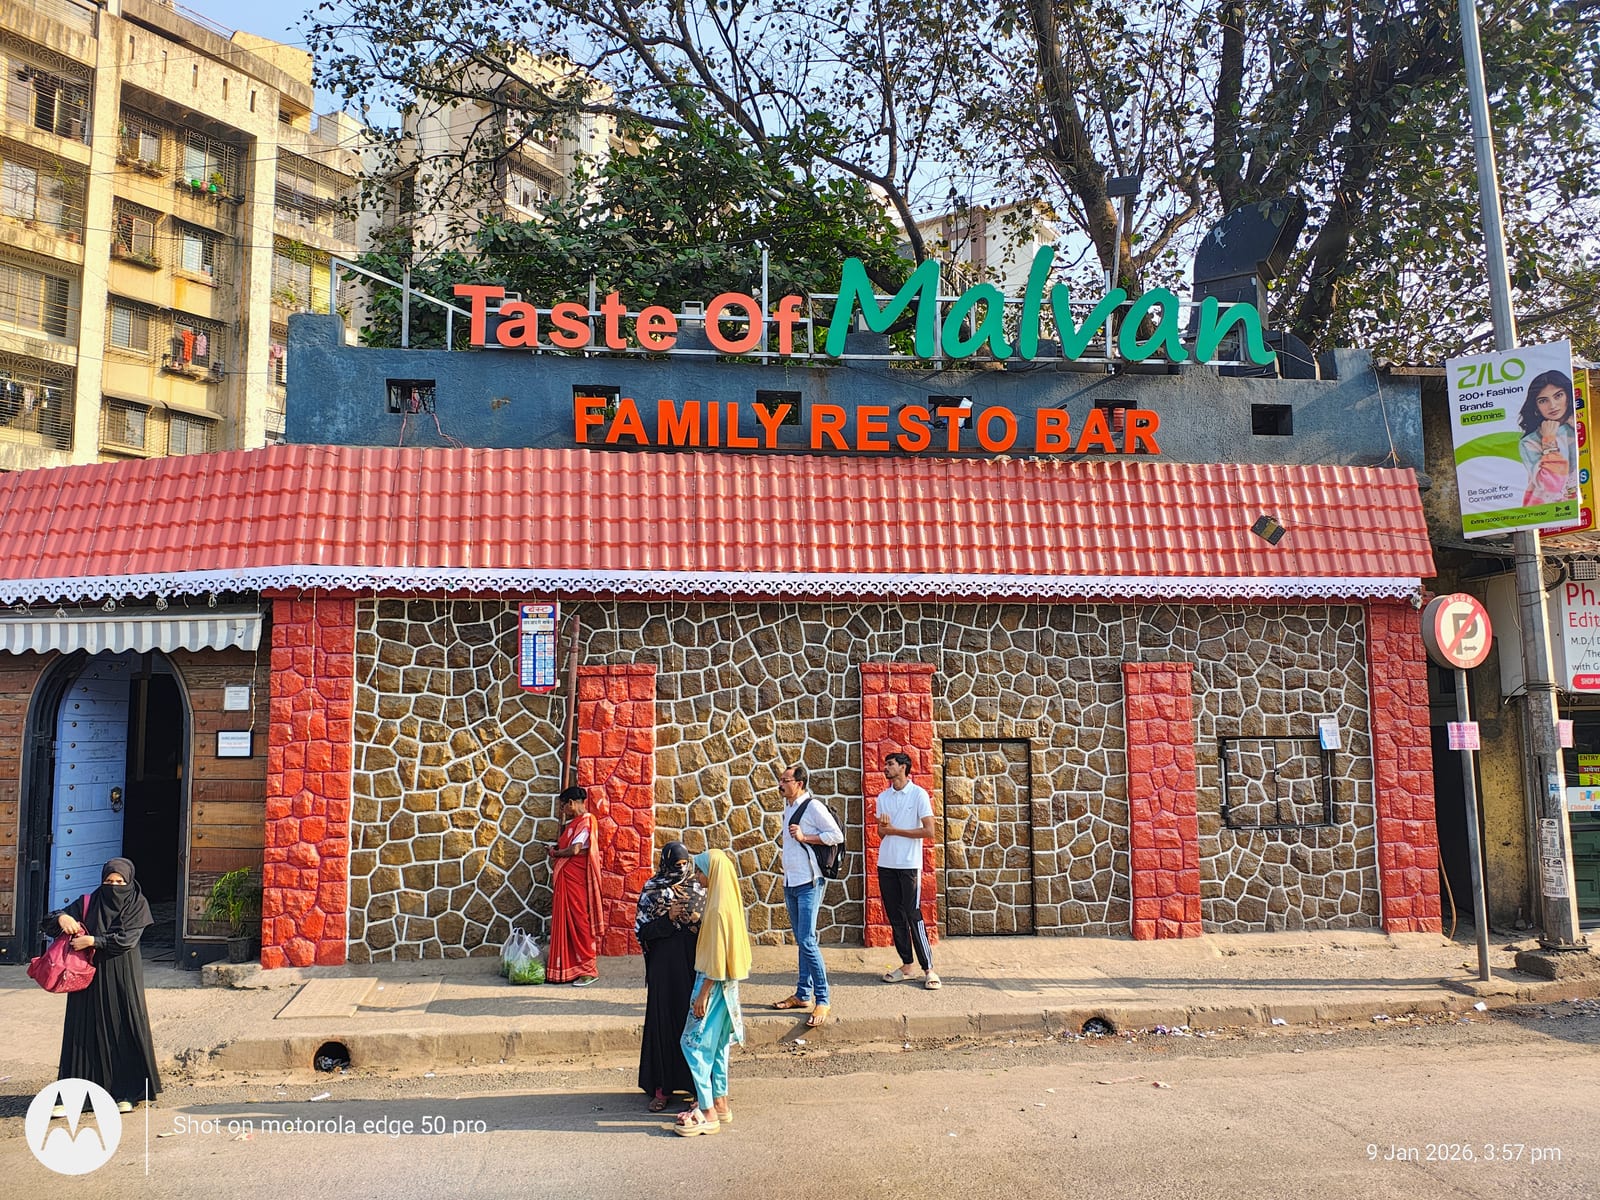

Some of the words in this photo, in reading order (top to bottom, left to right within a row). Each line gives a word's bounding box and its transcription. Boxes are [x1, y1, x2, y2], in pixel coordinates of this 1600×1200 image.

[454, 284, 677, 351] Taste
[705, 291, 802, 355] Of
[825, 245, 1277, 366] Malvan
[1457, 358, 1526, 390] ZILO
[1458, 391, 1485, 402] 200+
[1486, 386, 1524, 398] Fashion
[1460, 401, 1494, 412] Brands
[1470, 414, 1482, 422] 60
[575, 396, 792, 449] FAMILY
[810, 404, 1018, 453] RESTO
[1034, 407, 1162, 455] BAR
[1467, 489, 1477, 497] Be
[1478, 487, 1497, 497] Spoilt
[1468, 492, 1514, 504] Convenience
[1571, 662, 1591, 671] with
